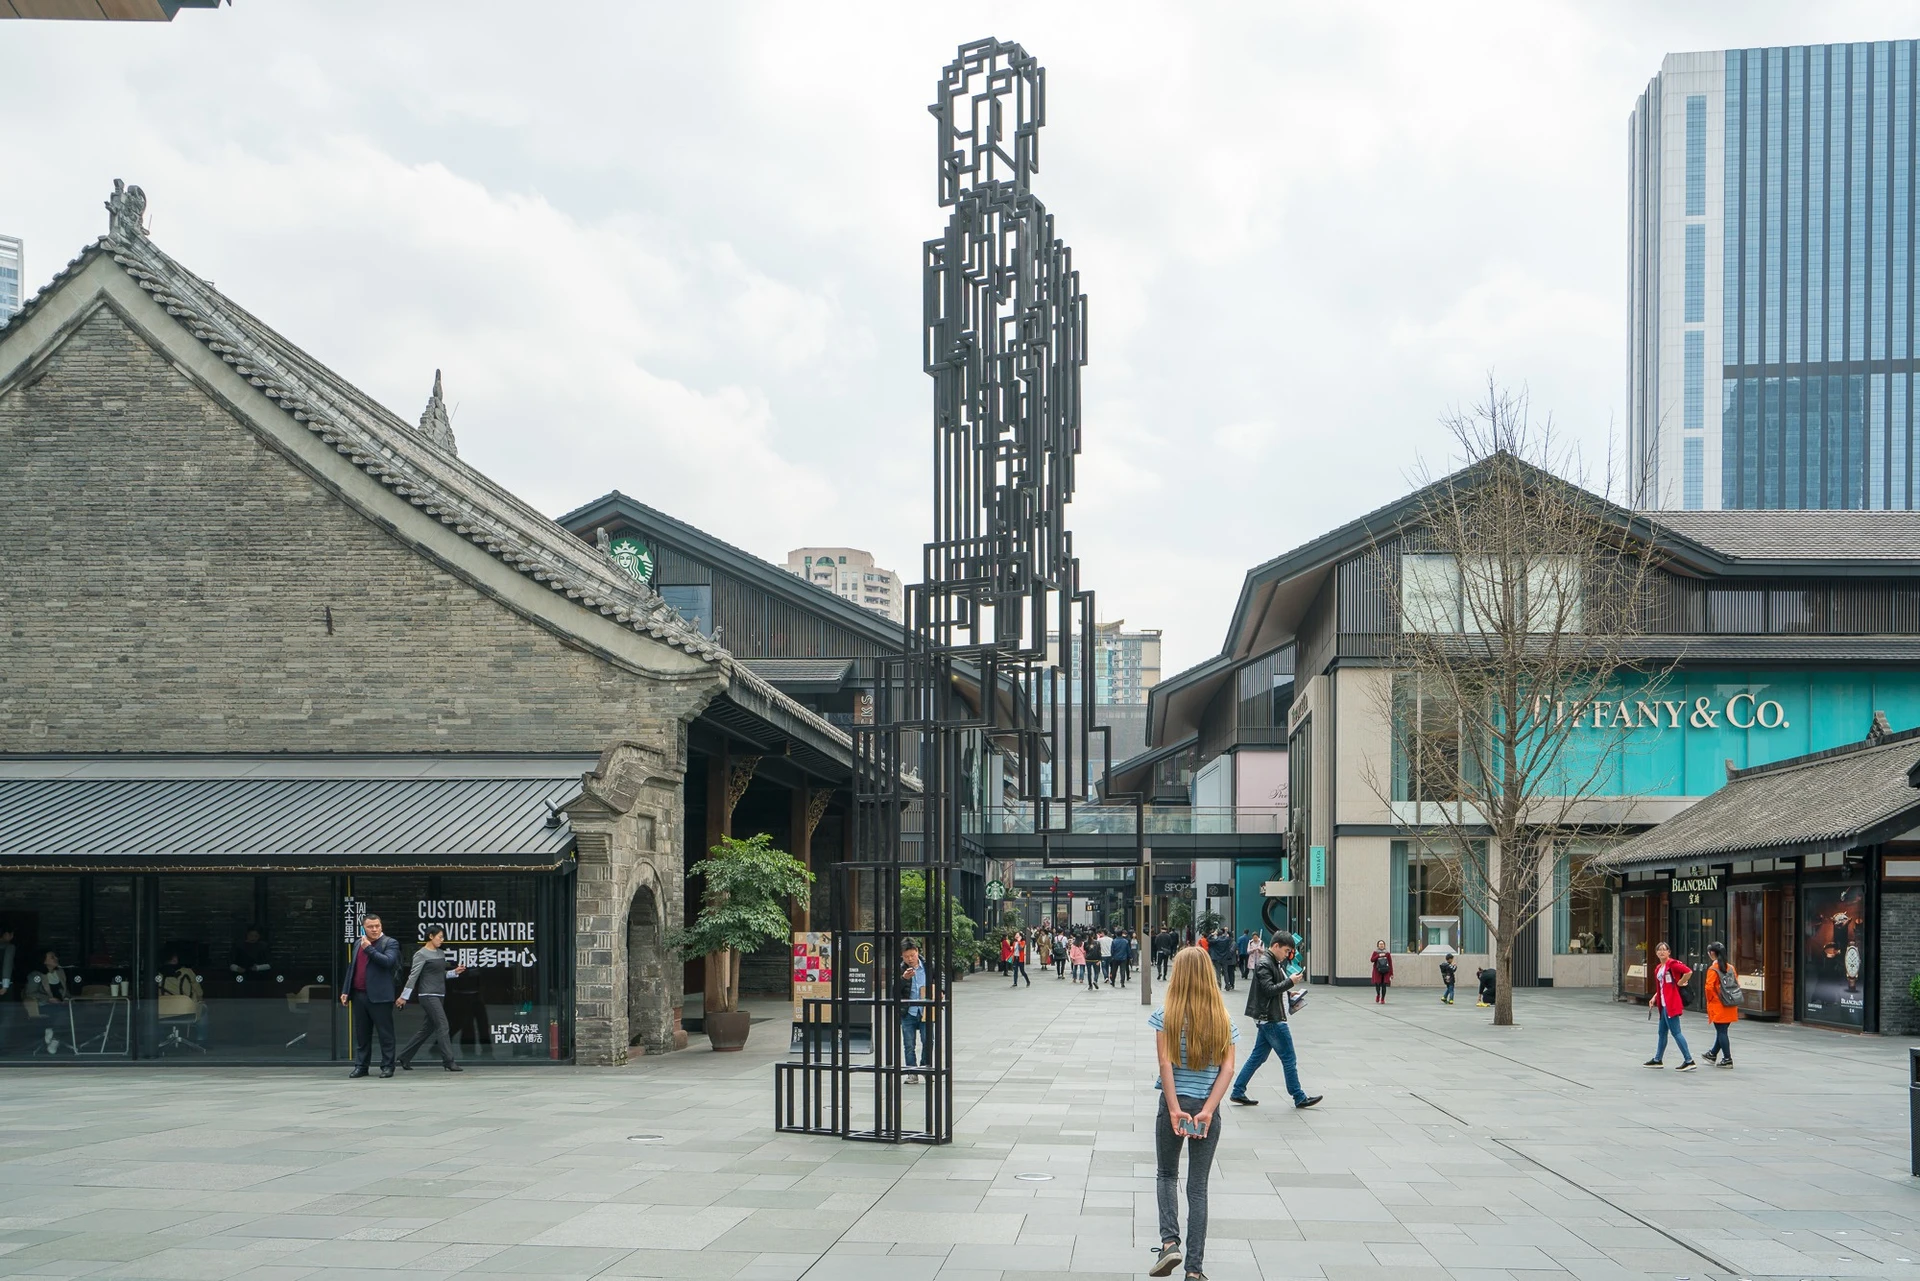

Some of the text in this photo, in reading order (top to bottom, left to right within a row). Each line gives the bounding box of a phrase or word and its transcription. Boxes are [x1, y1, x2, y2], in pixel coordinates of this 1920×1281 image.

[1671, 876, 1718, 892] BLANCPAIN
[355, 901, 366, 914] TAI
[418, 899, 496, 919] CUSTOMER
[417, 922, 535, 941] SVICE CENTRE
[443, 946, 537, 968] 户服务中心
[494, 1033, 524, 1044] PLAY
